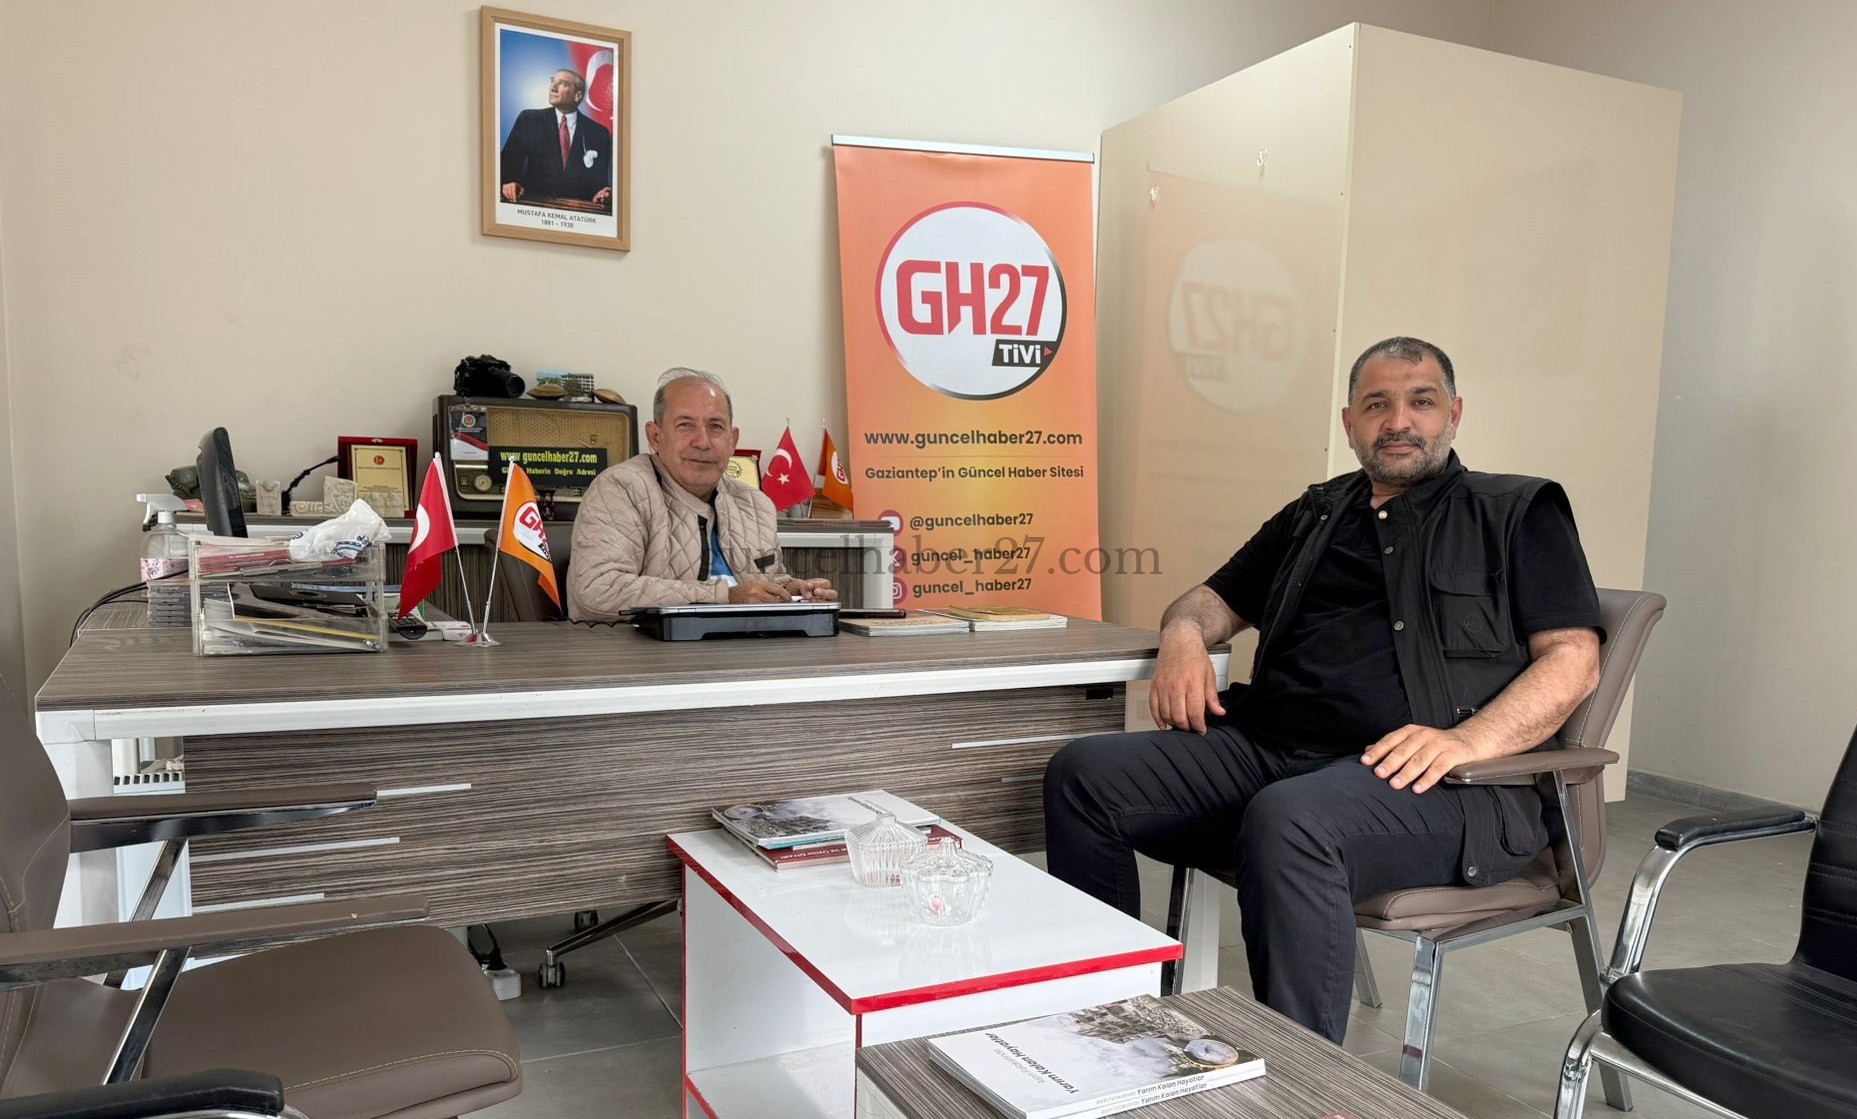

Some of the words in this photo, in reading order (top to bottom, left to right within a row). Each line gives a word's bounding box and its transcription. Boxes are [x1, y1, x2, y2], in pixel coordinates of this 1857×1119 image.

[517, 208, 546, 217] MUSTAFA
[547, 212, 568, 220] KEMAL
[569, 215, 597, 224] ATATÜRK
[895, 259, 1049, 336] GH27
[998, 343, 1042, 364] TiVi
[864, 430, 1083, 449] www.guncelhaber27.com
[527, 467, 551, 475] Haberin
[554, 467, 573, 476] Doğru
[958, 466, 1006, 478] Güncel
[1008, 466, 1048, 478] Haber
[1050, 465, 1084, 478] Sitesi
[910, 513, 1034, 531] @guncelhaber27
[911, 547, 1031, 566] guncel_haber27
[912, 578, 1032, 598] guncel_haber27
[1157, 1081, 1177, 1091] Kalan
[1177, 1075, 1204, 1087] Hayatlar
